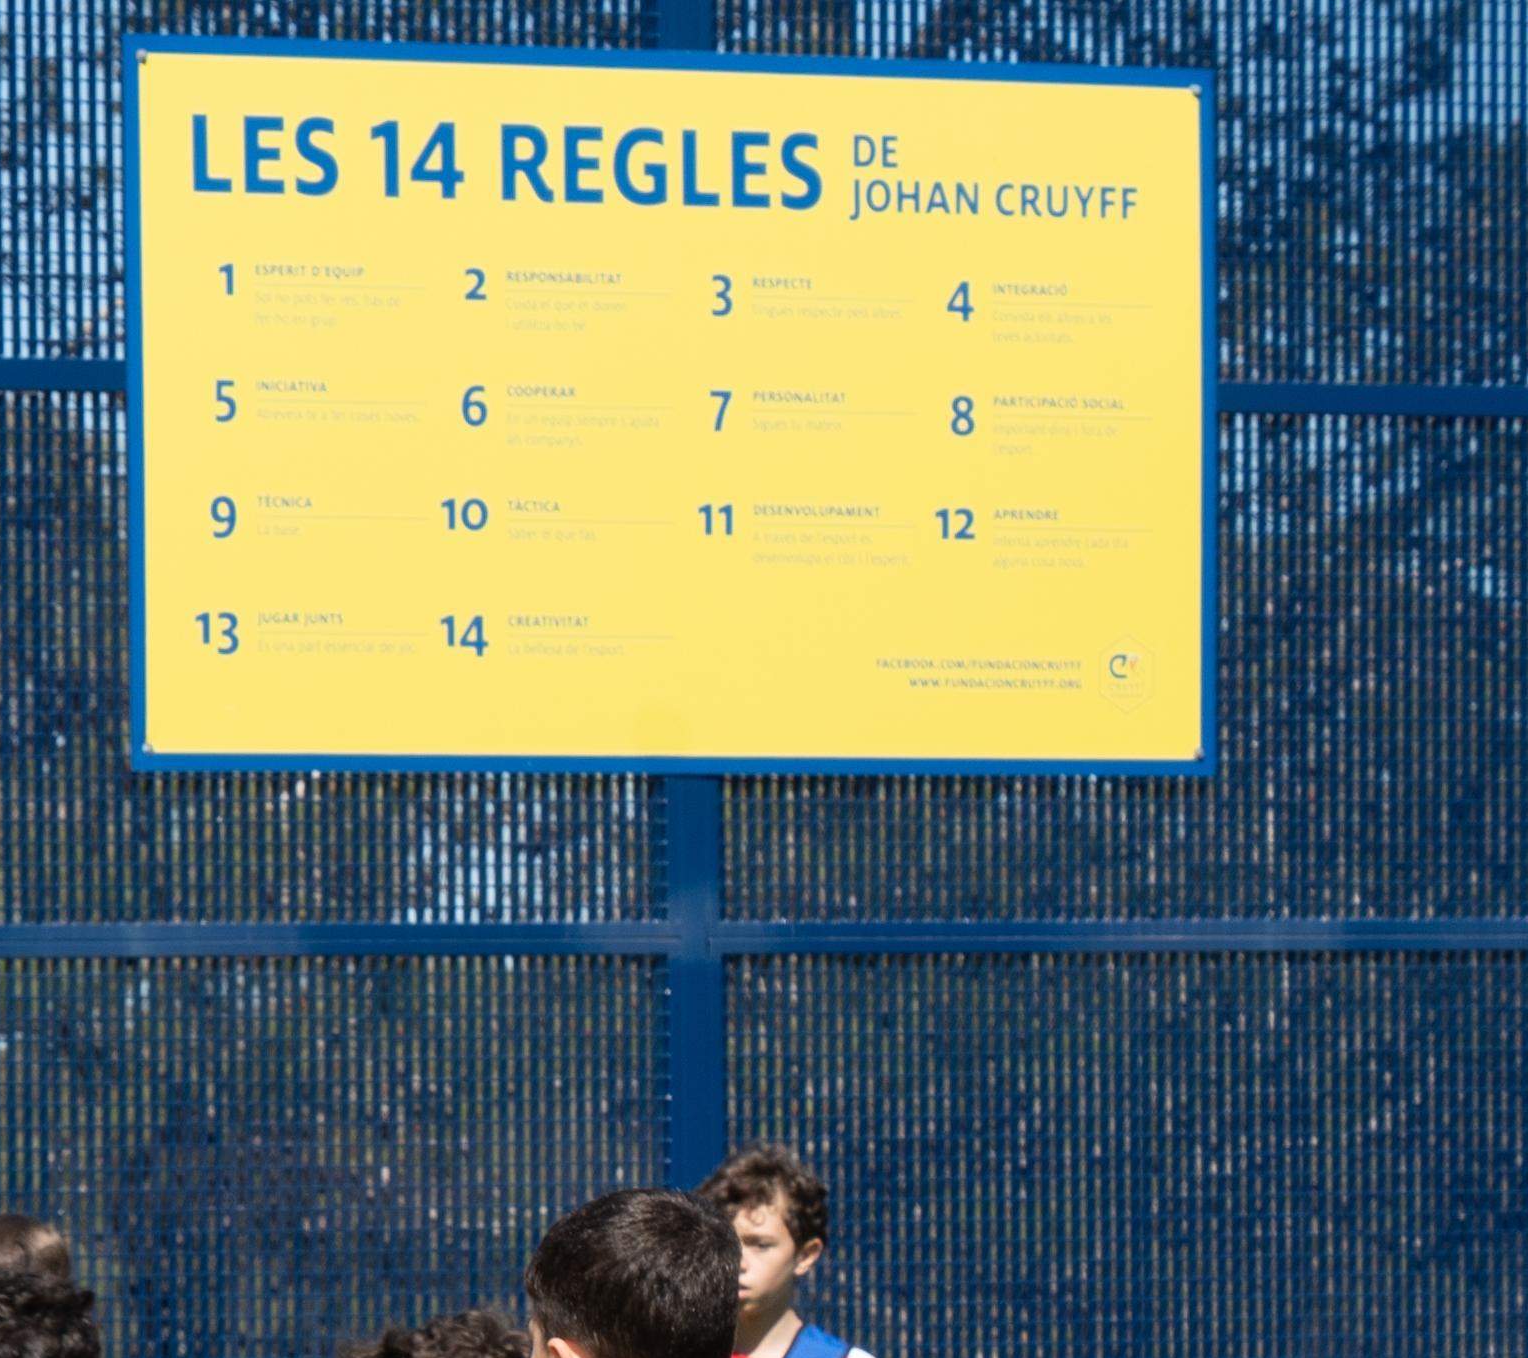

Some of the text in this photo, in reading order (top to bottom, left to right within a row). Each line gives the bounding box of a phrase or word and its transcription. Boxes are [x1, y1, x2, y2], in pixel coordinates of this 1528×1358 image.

[191, 114, 823, 211] LES 14 REGLES
[853, 134, 898, 169] DE
[849, 179, 1138, 221] JOHAN CRUYFF
[218, 263, 234, 296] 1
[254, 264, 306, 277] ESPERIT
[464, 267, 487, 301] 2
[505, 270, 622, 285] RESPONSABILITAT
[752, 276, 812, 290] RESPECTE
[711, 274, 733, 317] 3
[946, 281, 975, 322] 4
[215, 379, 237, 423] 5
[256, 380, 328, 393] INICIATIVA
[506, 385, 576, 398] COOPERAR
[752, 390, 846, 404] PERSONALITAT
[461, 385, 488, 427] 6
[709, 390, 732, 432] 7
[950, 395, 975, 437] 8
[1082, 398, 1125, 411] SOCIAL
[210, 495, 237, 539] 9
[440, 498, 489, 532] 10
[698, 503, 733, 536] 11
[753, 505, 879, 518] DESENVOLUPAMENT
[935, 508, 976, 540] 12
[993, 509, 1058, 521] APRENDRE
[195, 611, 240, 655] 13
[257, 612, 344, 626] JUGAR JUNTS
[508, 615, 589, 628] CREATIVITAT
[440, 615, 489, 657] 14
